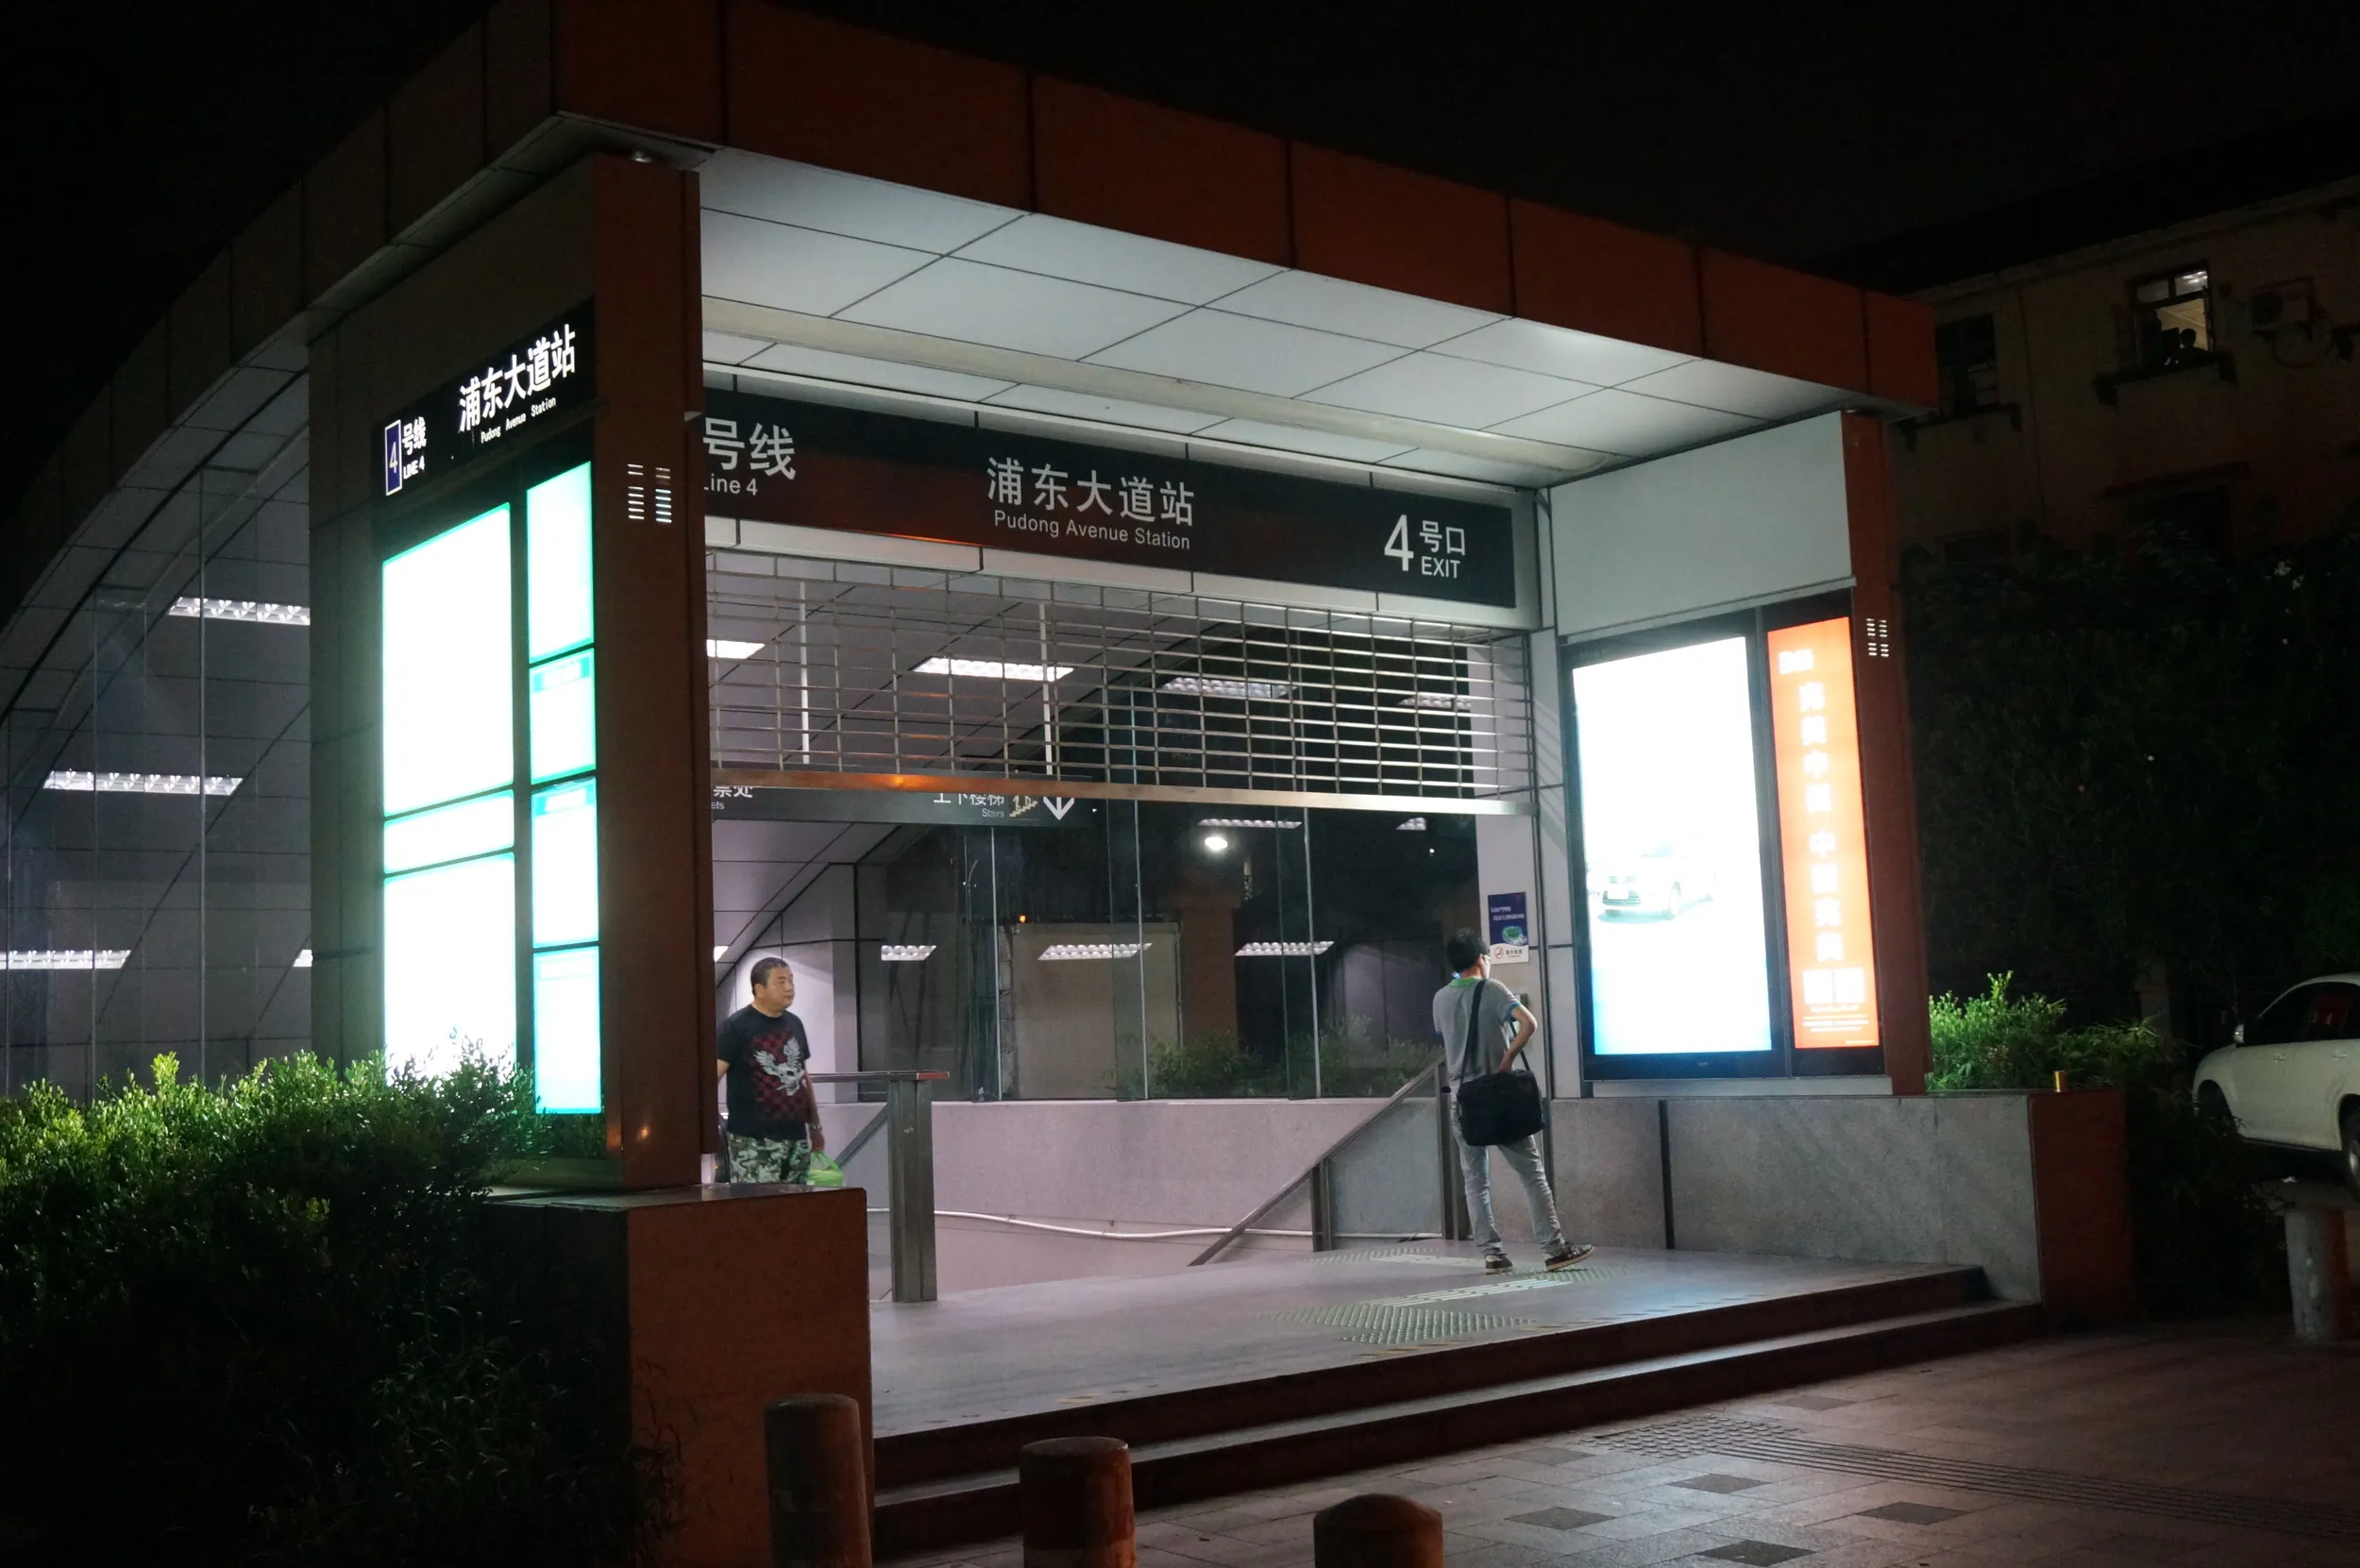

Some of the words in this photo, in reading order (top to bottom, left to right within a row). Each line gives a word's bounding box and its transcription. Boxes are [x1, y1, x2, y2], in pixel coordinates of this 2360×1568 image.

[459, 323, 576, 432] 浦东大道站
[389, 441, 397, 473] 4
[402, 416, 428, 455] 号线
[480, 426, 501, 444] Pudong
[505, 413, 527, 430] Avenue
[531, 397, 557, 417] Station
[703, 416, 797, 481] 号线
[703, 473, 741, 494] ine
[746, 478, 758, 496] 4
[986, 456, 1194, 527] 浦东大道站
[994, 509, 1059, 538] Pudong
[1066, 519, 1129, 543] Avenue
[1135, 527, 1190, 550] Station
[1384, 514, 1414, 572] 4
[1419, 519, 1466, 556] 号口
[1421, 555, 1461, 579] EXIT
[981, 808, 1005, 818] Stairs
